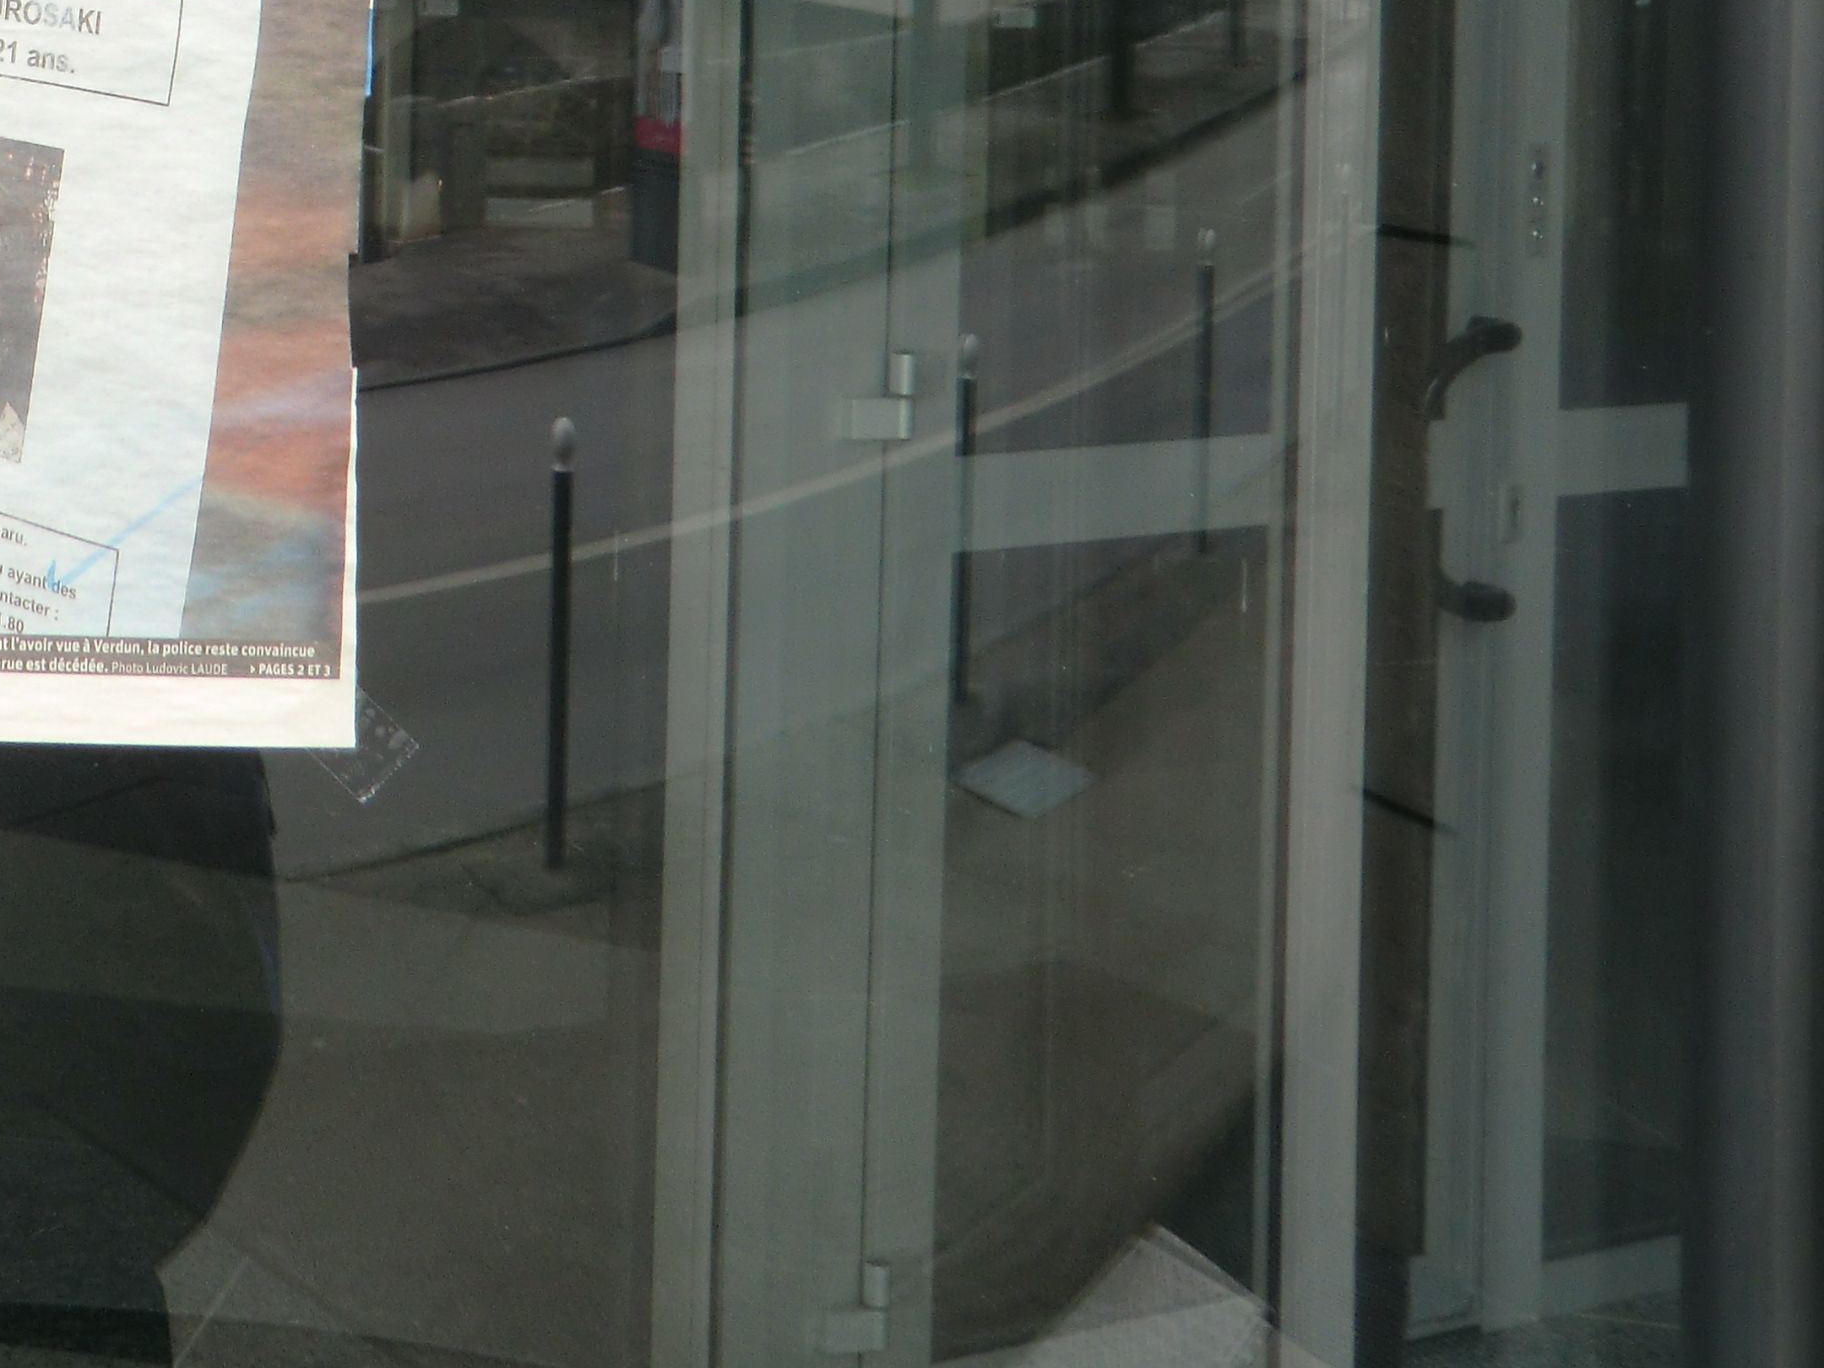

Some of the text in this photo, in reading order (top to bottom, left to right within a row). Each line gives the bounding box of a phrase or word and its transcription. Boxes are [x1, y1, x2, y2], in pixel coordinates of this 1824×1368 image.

[27, 49, 76, 74] ans.
[7, 566, 48, 592] ayant
[51, 579, 78, 600] des
[11, 636, 53, 652] l'avoir
[56, 640, 80, 653] vue
[83, 638, 90, 653] à
[94, 639, 145, 656] Verdun,
[148, 640, 160, 655] la
[162, 641, 202, 657] police
[205, 643, 239, 657] reste
[241, 643, 315, 658] convaincue
[26, 658, 46, 672] est
[49, 658, 108, 673] décédée.
[111, 661, 143, 674] Photo
[146, 662, 188, 675] Ludovic
[191, 663, 227, 676] LAUDE
[258, 664, 331, 677] PAGES 2 ET 3
